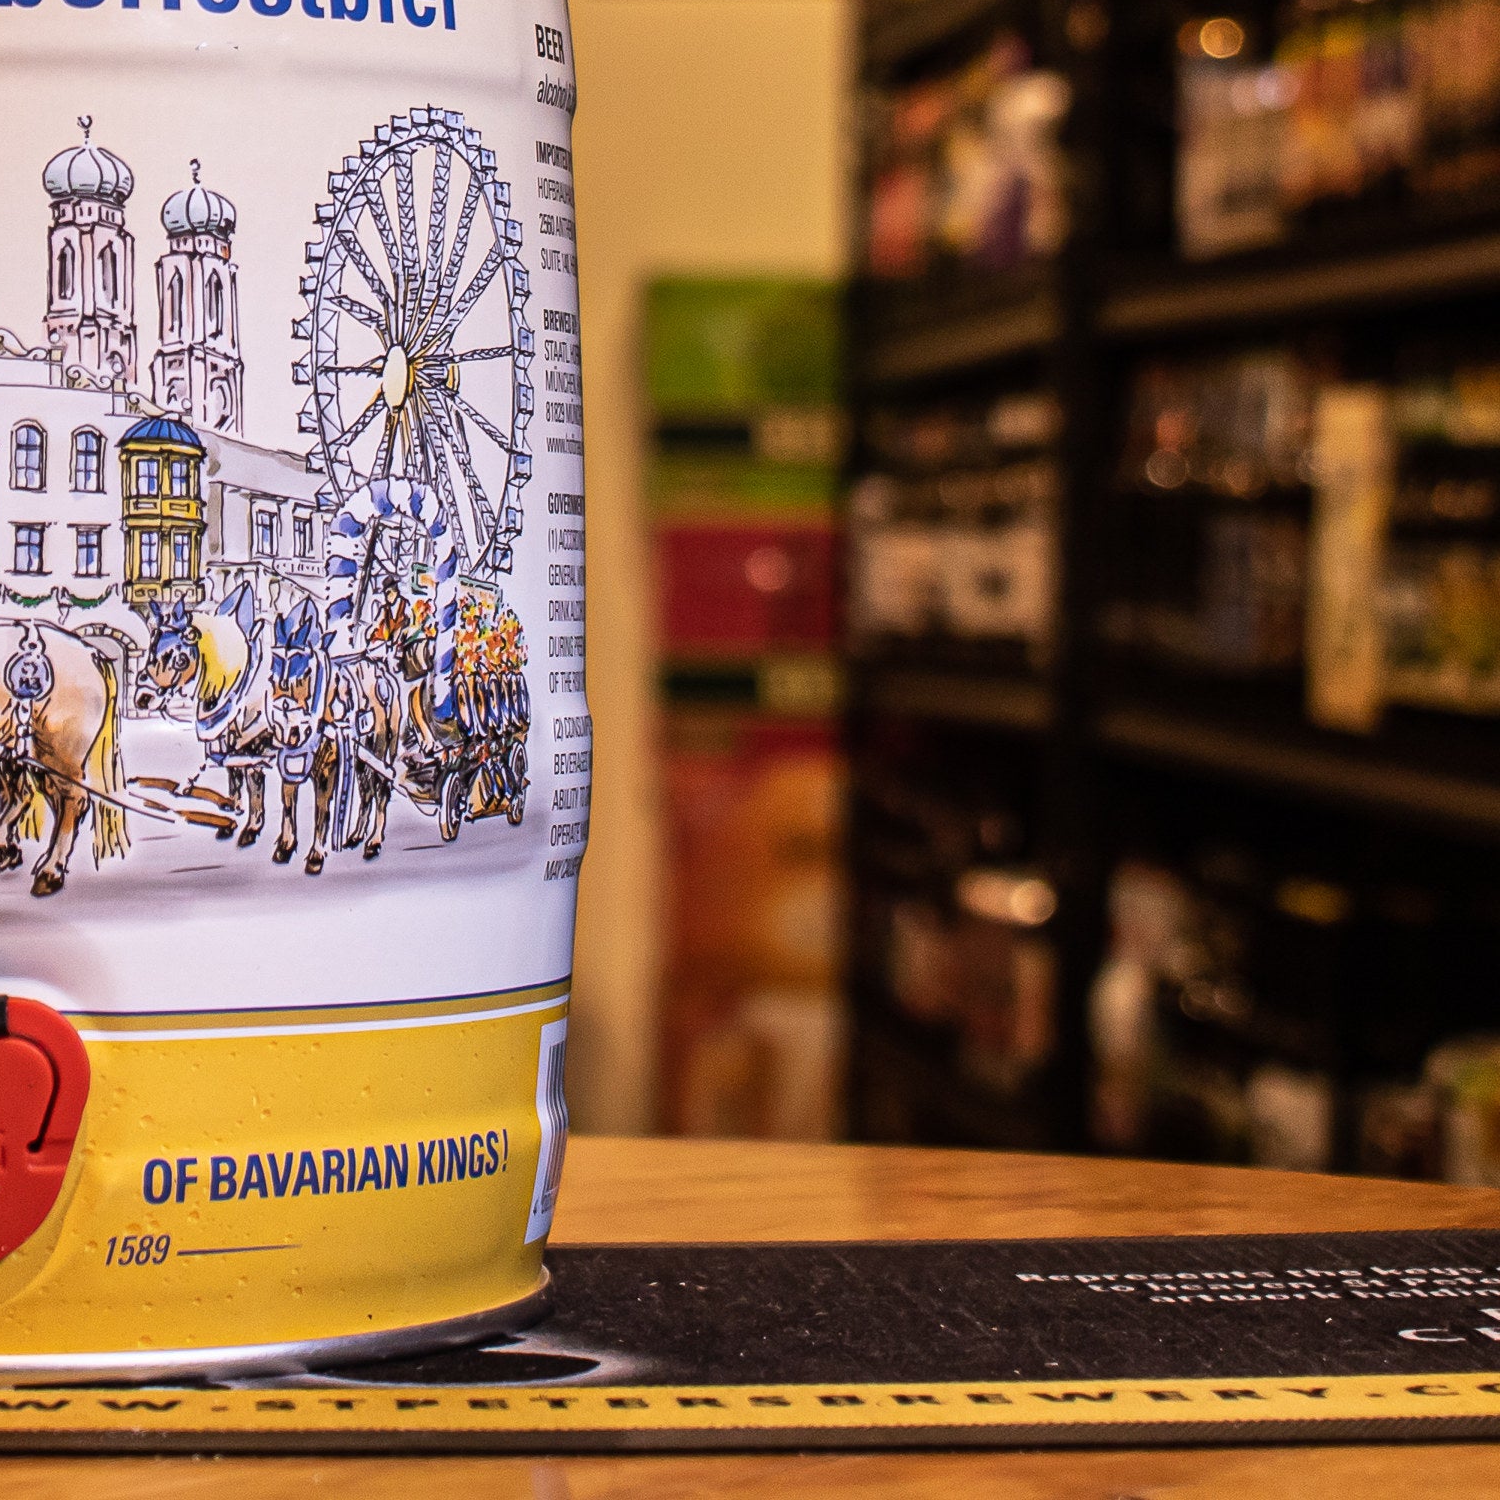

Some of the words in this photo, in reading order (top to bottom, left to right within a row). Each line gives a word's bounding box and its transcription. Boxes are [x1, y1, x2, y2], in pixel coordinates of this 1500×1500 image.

[534, 23, 565, 65] BEER
[143, 1156, 200, 1205] OF
[209, 1142, 409, 1202] BAVARIAN
[416, 1128, 509, 1186] KINGS!
[104, 1233, 171, 1267] 1589
